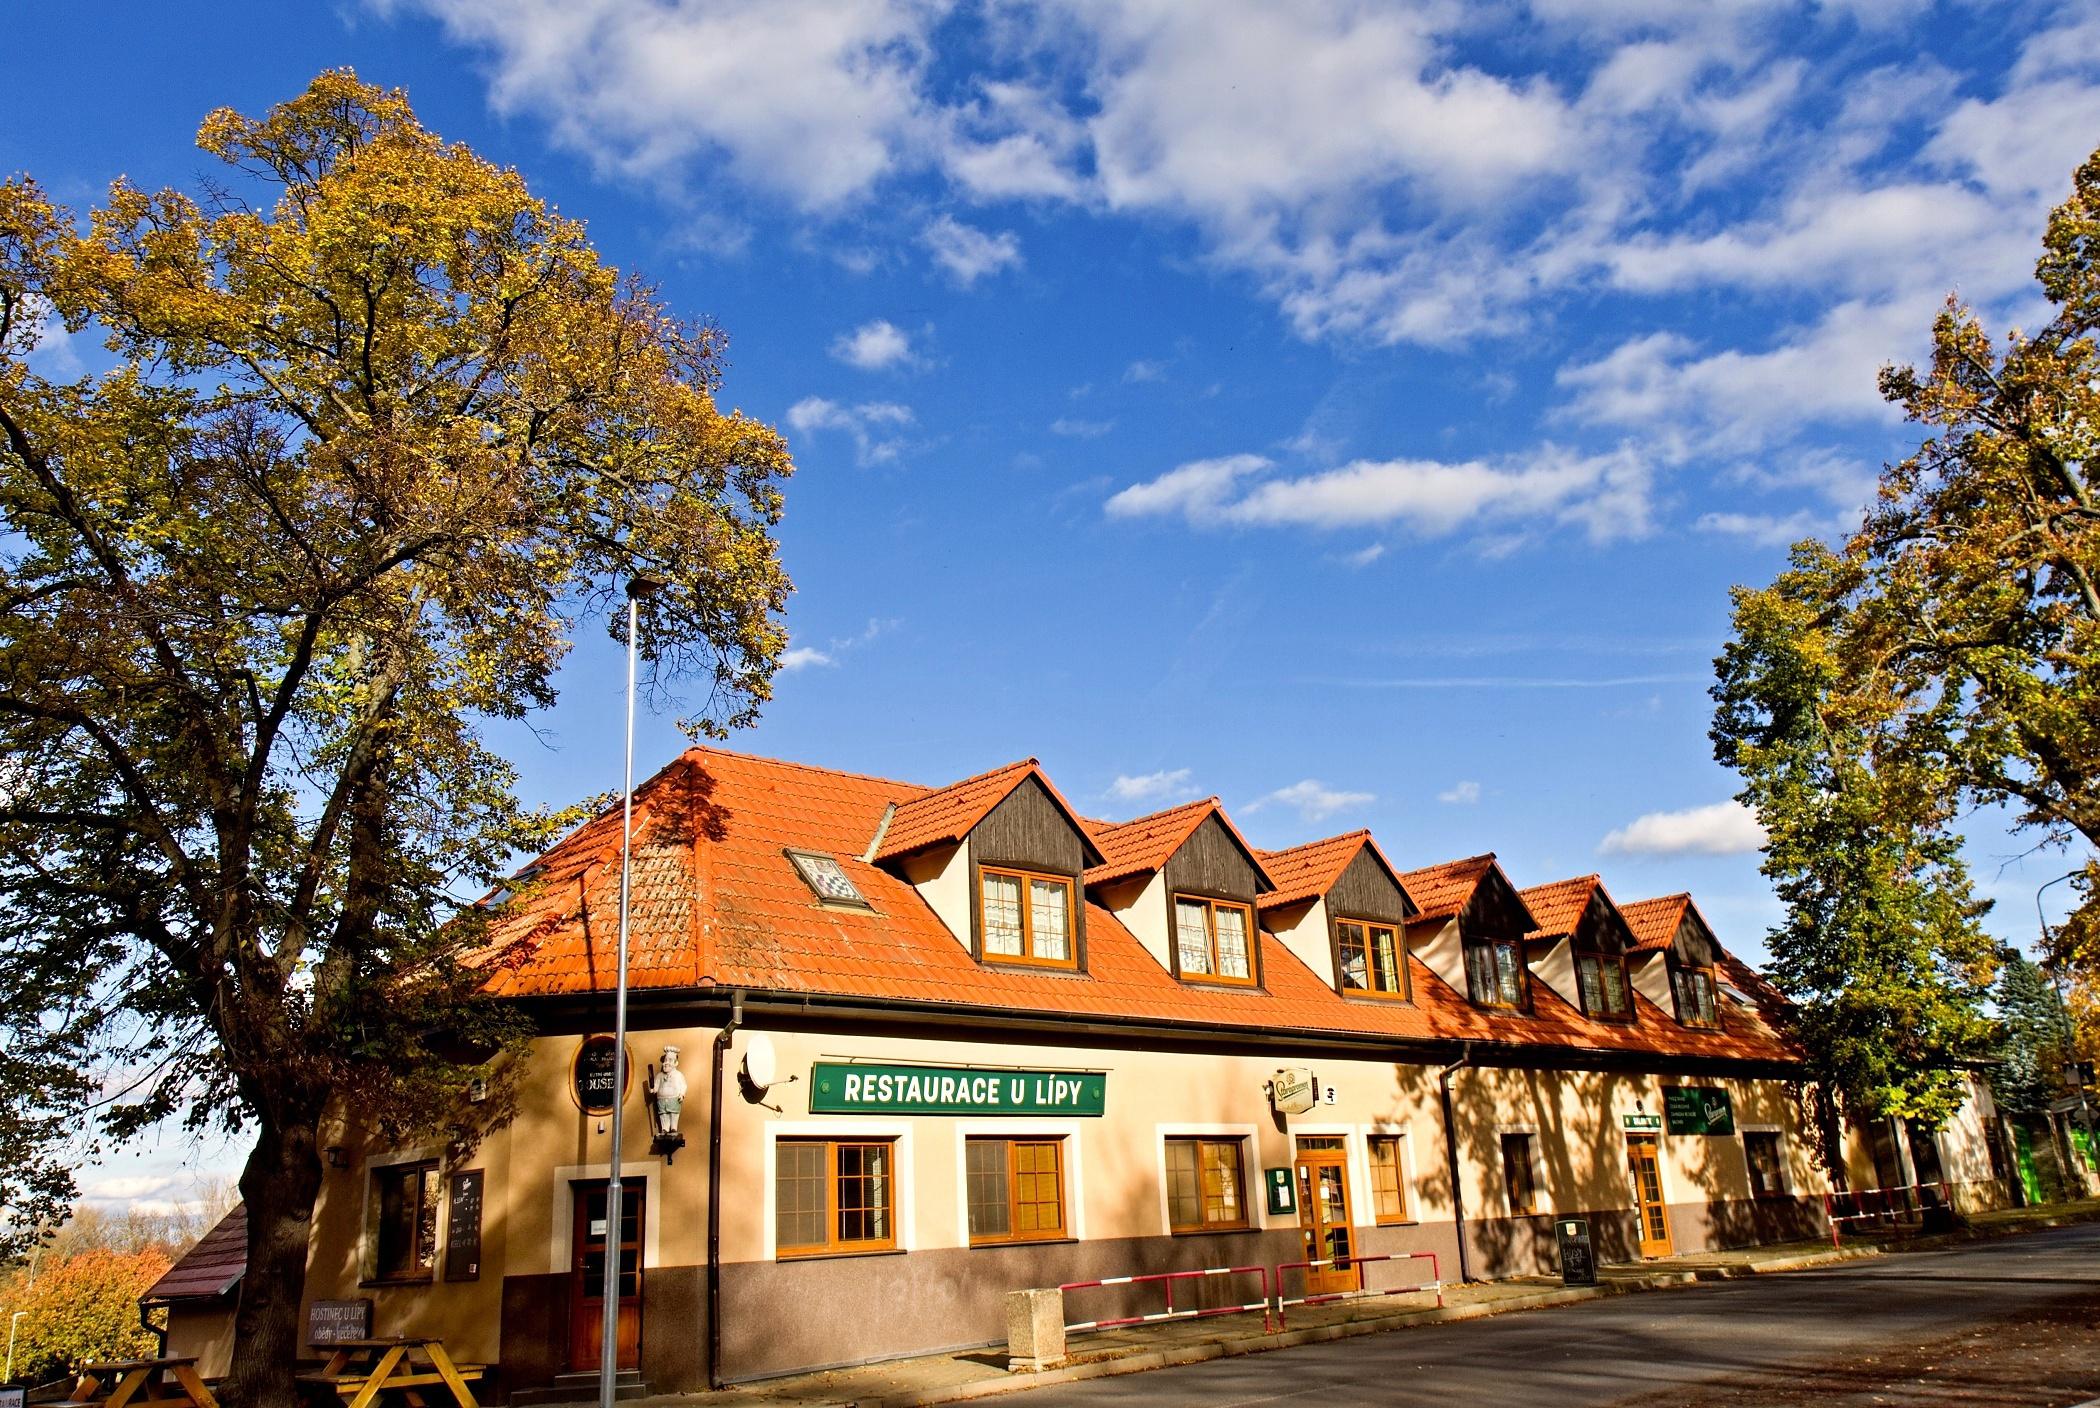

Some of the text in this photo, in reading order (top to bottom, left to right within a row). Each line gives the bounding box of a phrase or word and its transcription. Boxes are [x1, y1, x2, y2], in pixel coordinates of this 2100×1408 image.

[844, 1073, 1083, 1105] RESTAURACE U LÍPY
[310, 1302, 366, 1320] HOSTINEC U LÍPY
